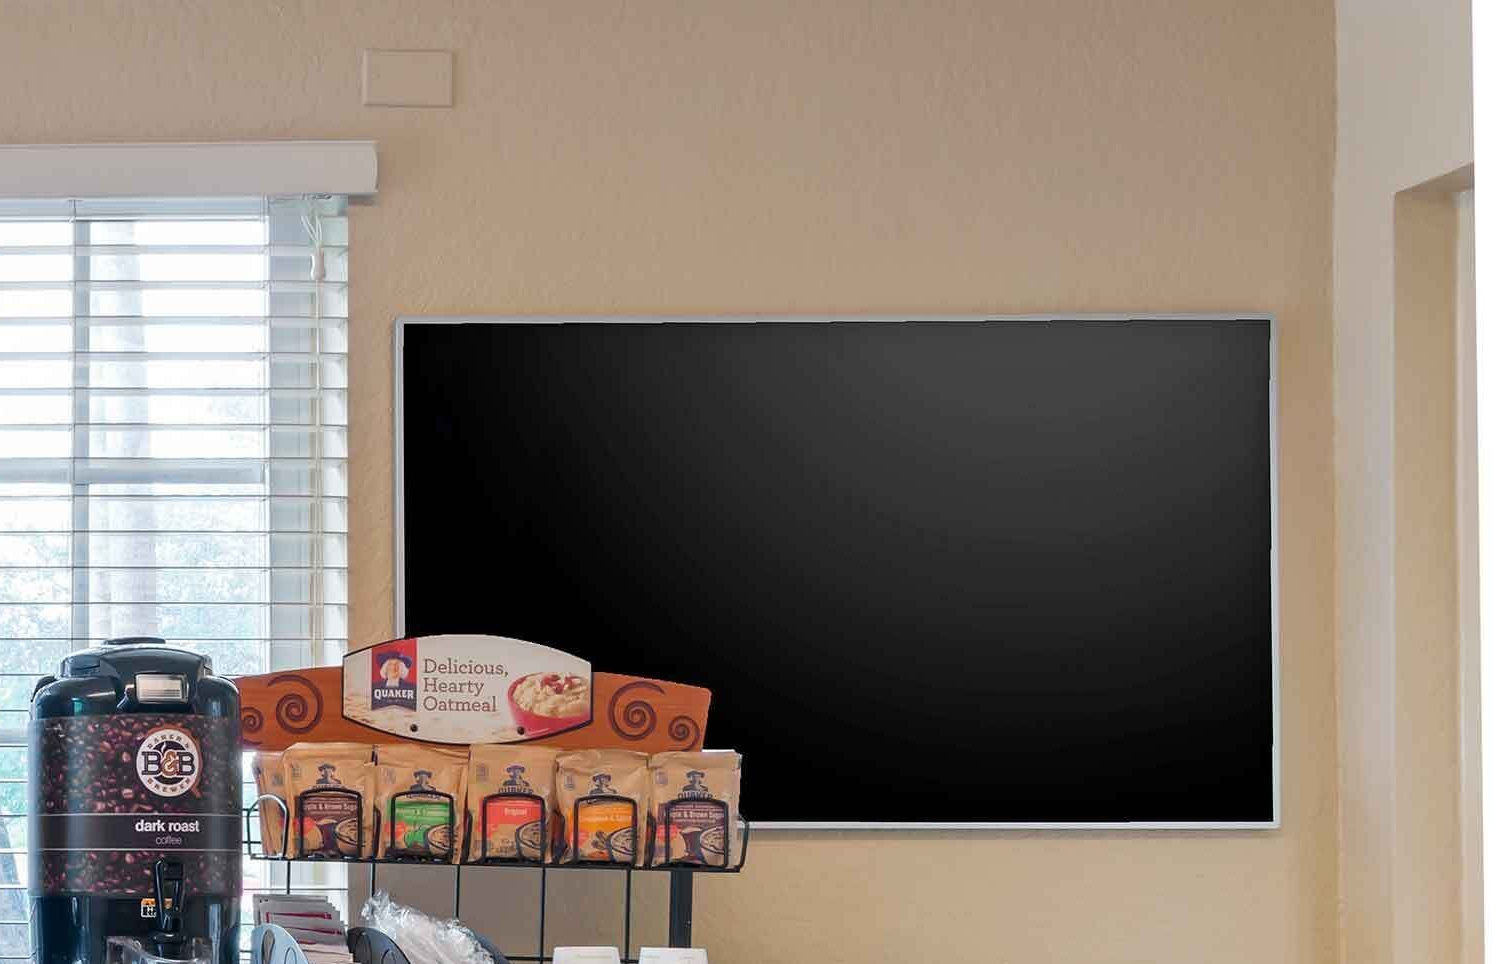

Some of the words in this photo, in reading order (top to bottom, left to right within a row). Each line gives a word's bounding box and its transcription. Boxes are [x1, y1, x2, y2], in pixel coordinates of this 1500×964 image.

[424, 658, 509, 677] Delicious,
[374, 689, 414, 700] QUAKER
[423, 677, 484, 696] Hearty
[423, 696, 496, 712] Oatmeal
[141, 751, 195, 777] B&B
[135, 820, 165, 832] dark
[168, 820, 199, 832] roast
[155, 835, 182, 845] coffee
